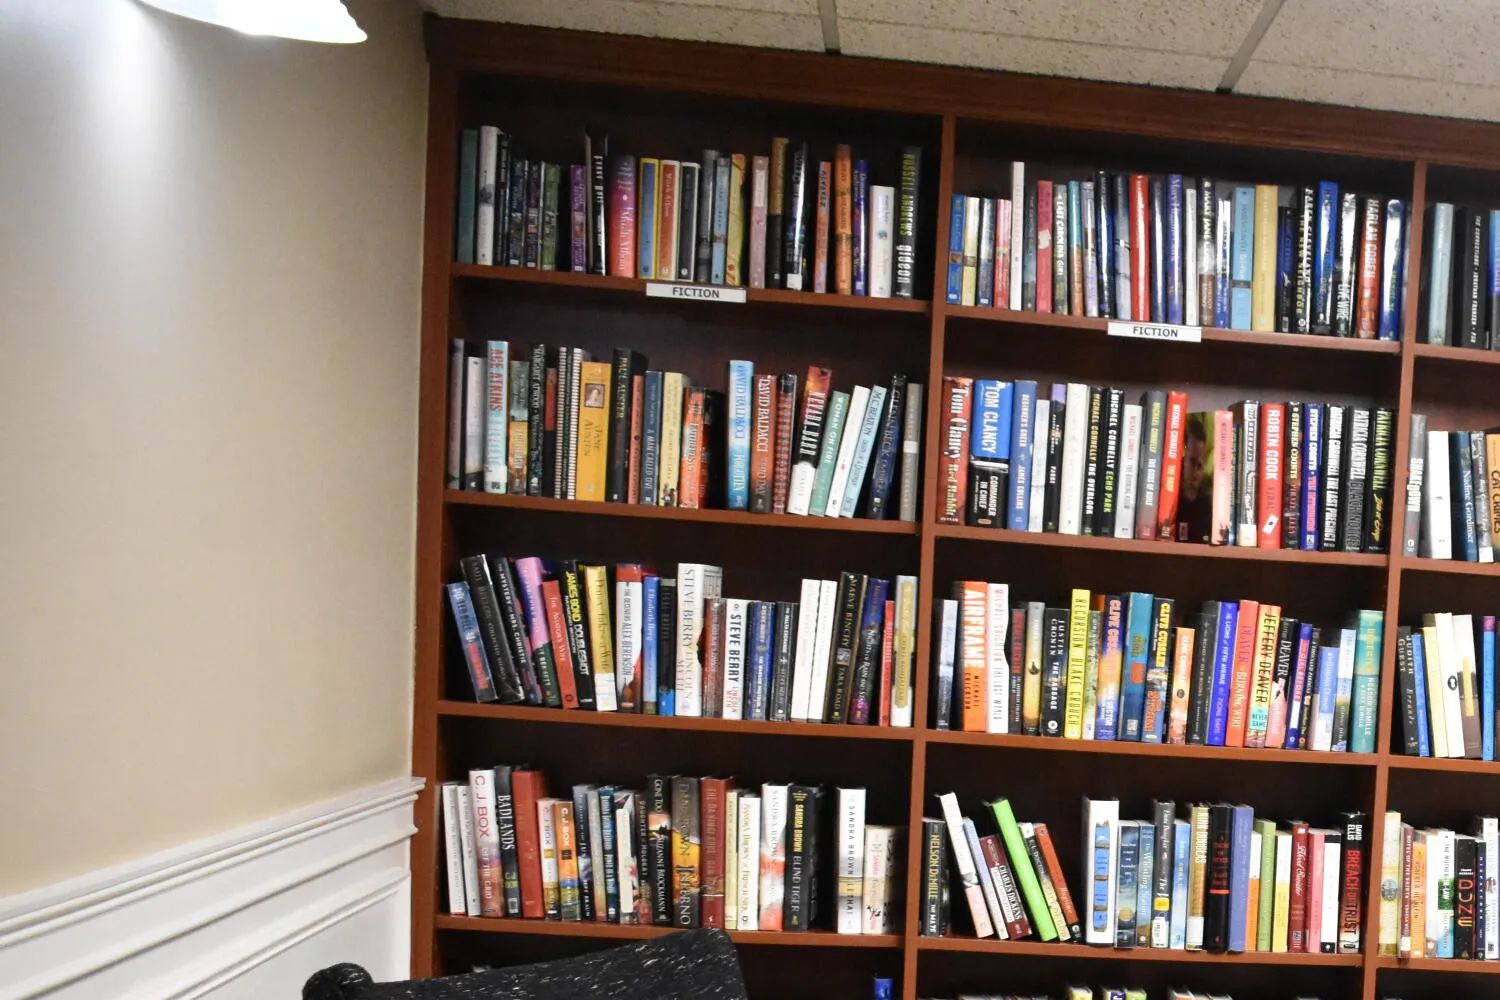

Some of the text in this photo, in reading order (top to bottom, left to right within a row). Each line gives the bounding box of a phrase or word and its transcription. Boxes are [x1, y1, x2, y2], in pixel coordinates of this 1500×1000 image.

[896, 153, 917, 284] RUSSELL ANDREWS gideon
[1363, 199, 1380, 278] HARLAN COBEN
[672, 287, 720, 298] FICTION
[1133, 326, 1178, 338] FICTION
[489, 348, 504, 411] ACE ATKINS
[756, 378, 771, 452] DAVID BALDACCI
[824, 397, 844, 465] WOMAN ON FIRE
[981, 386, 1001, 453] TOM CLANCY
[1265, 409, 1280, 480] ROBIN COOK
[944, 387, 968, 516] Tom Clancy Red Rabbit
[1103, 394, 1119, 512] MICHAEL CONNELLY ECHO PARK
[978, 482, 987, 509] IN CHIEF
[987, 476, 998, 516] COMMANDER
[1462, 470, 1475, 544] Nadine Gordimer
[566, 571, 589, 675] JAMES BOND DOUBLESHOT
[727, 614, 741, 682] STEVE BERRY
[961, 590, 986, 668] AIRFRAME
[1049, 619, 1058, 656] CRONIN
[1057, 620, 1065, 655] JUSTIN
[1049, 662, 1059, 710] THE PASSAGE
[1067, 599, 1086, 726] RECURSION BLAKE CROUCH
[1255, 613, 1277, 703] JEFFERY DEAVER
[498, 795, 512, 850] BADLANDS
[791, 804, 804, 912] SANDRA BROWN BLIND TIGER
[1346, 850, 1361, 890] BREACH
[1343, 903, 1358, 935] TRUST
